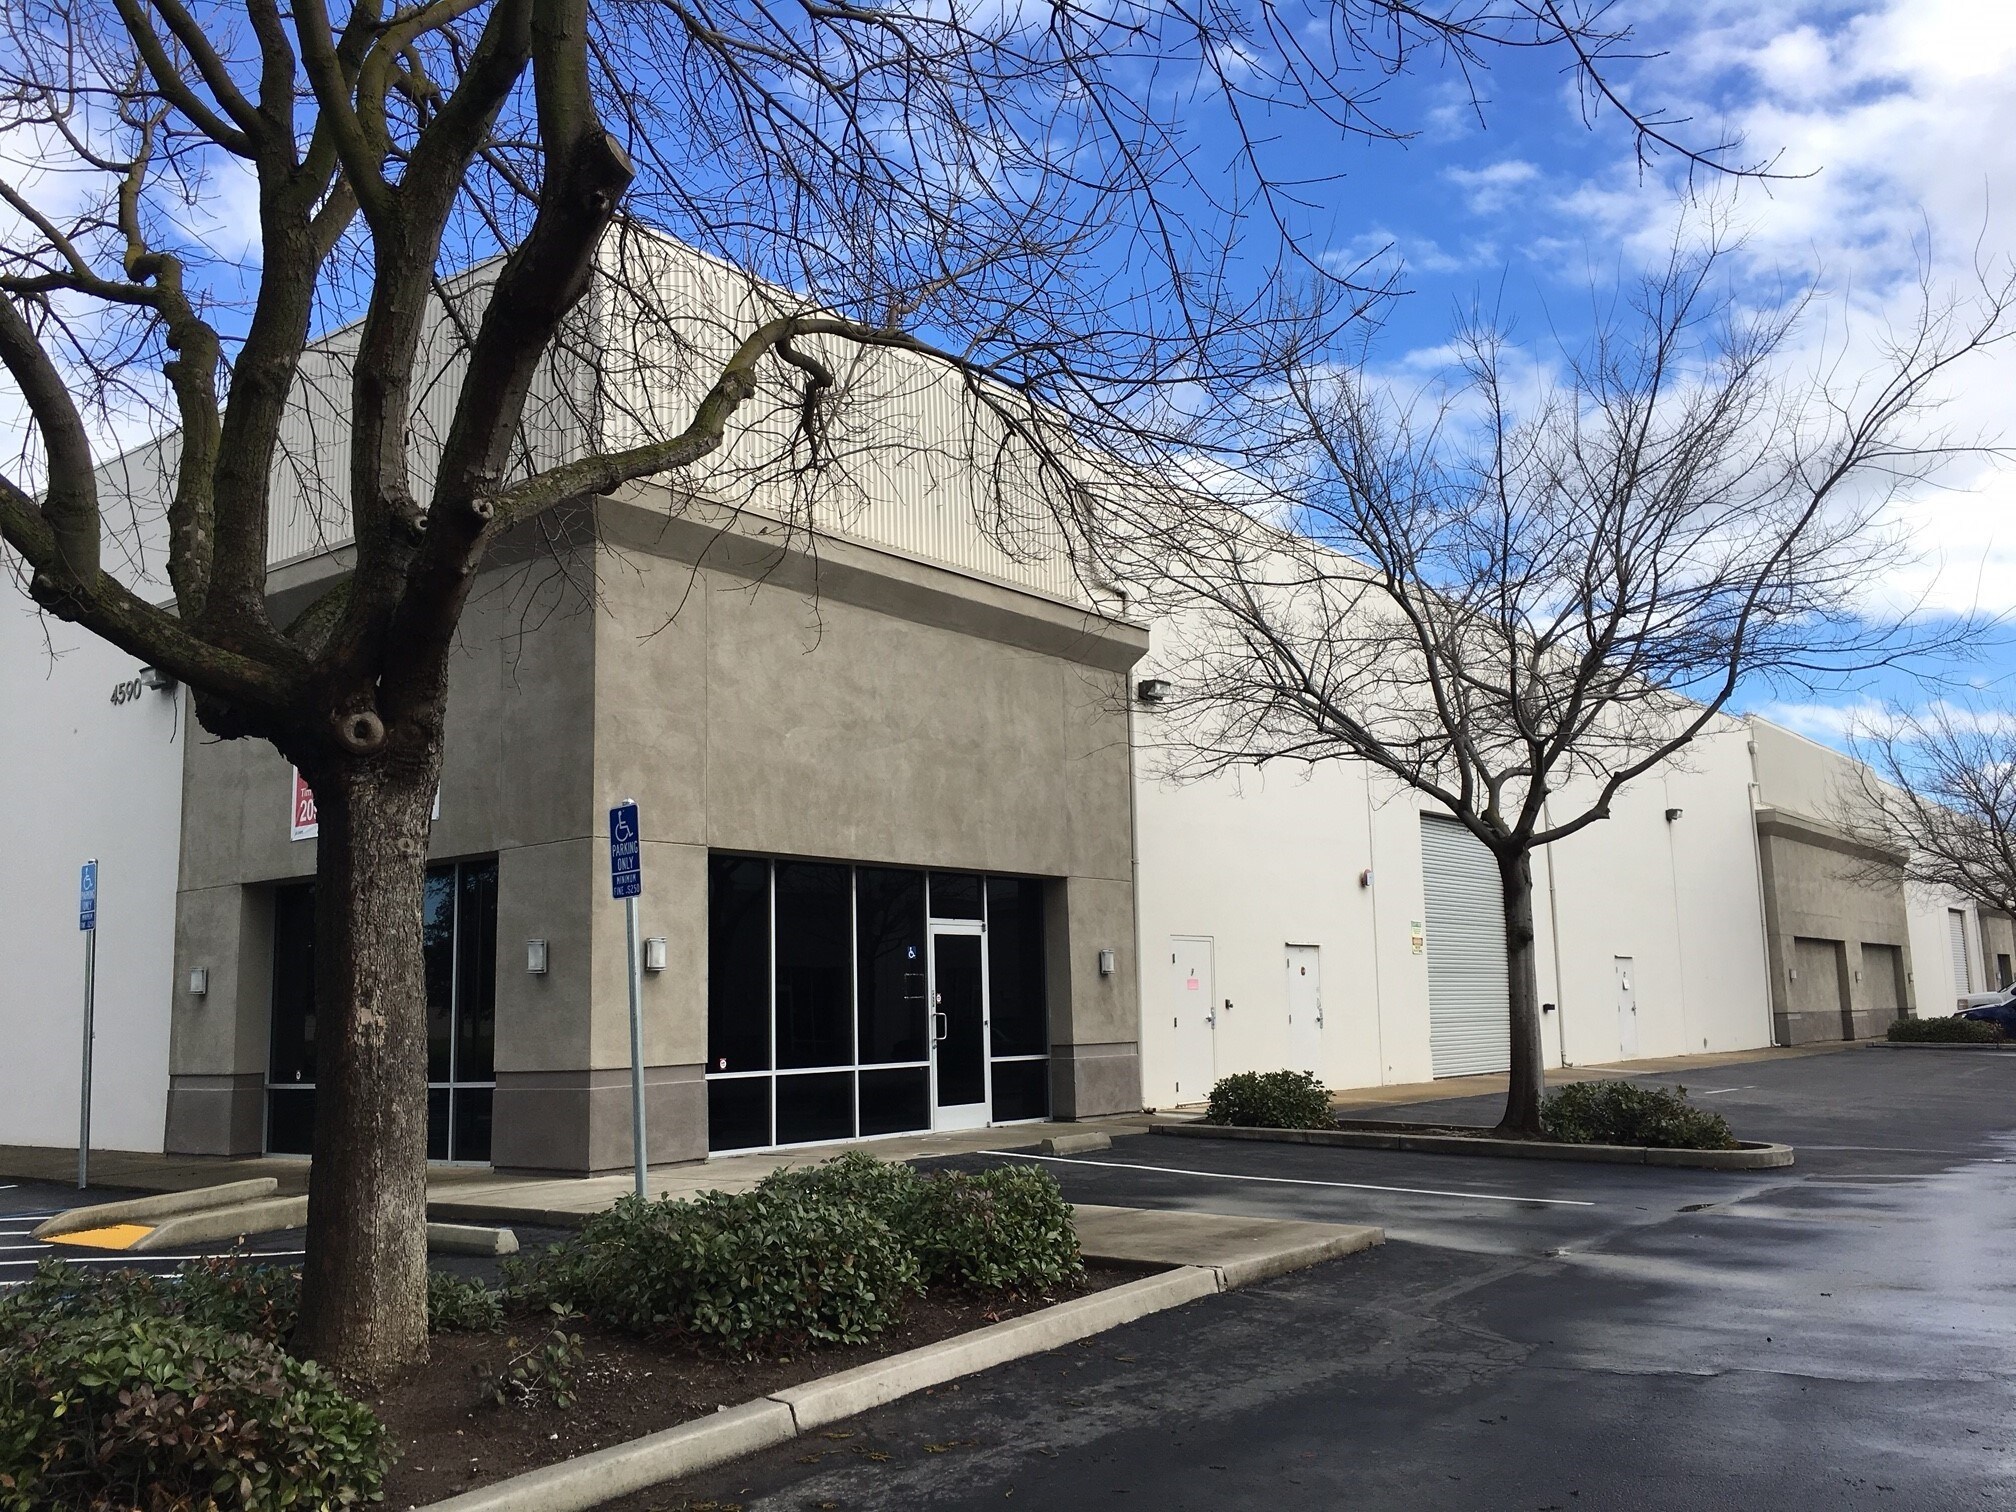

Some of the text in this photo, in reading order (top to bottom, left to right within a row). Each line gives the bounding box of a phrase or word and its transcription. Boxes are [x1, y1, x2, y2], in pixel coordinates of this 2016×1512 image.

[110, 678, 141, 706] 4590
[612, 840, 638, 857] PARKING
[617, 856, 634, 871] ONLY
[616, 873, 637, 884] MINIMUM
[613, 885, 624, 896] FINE
